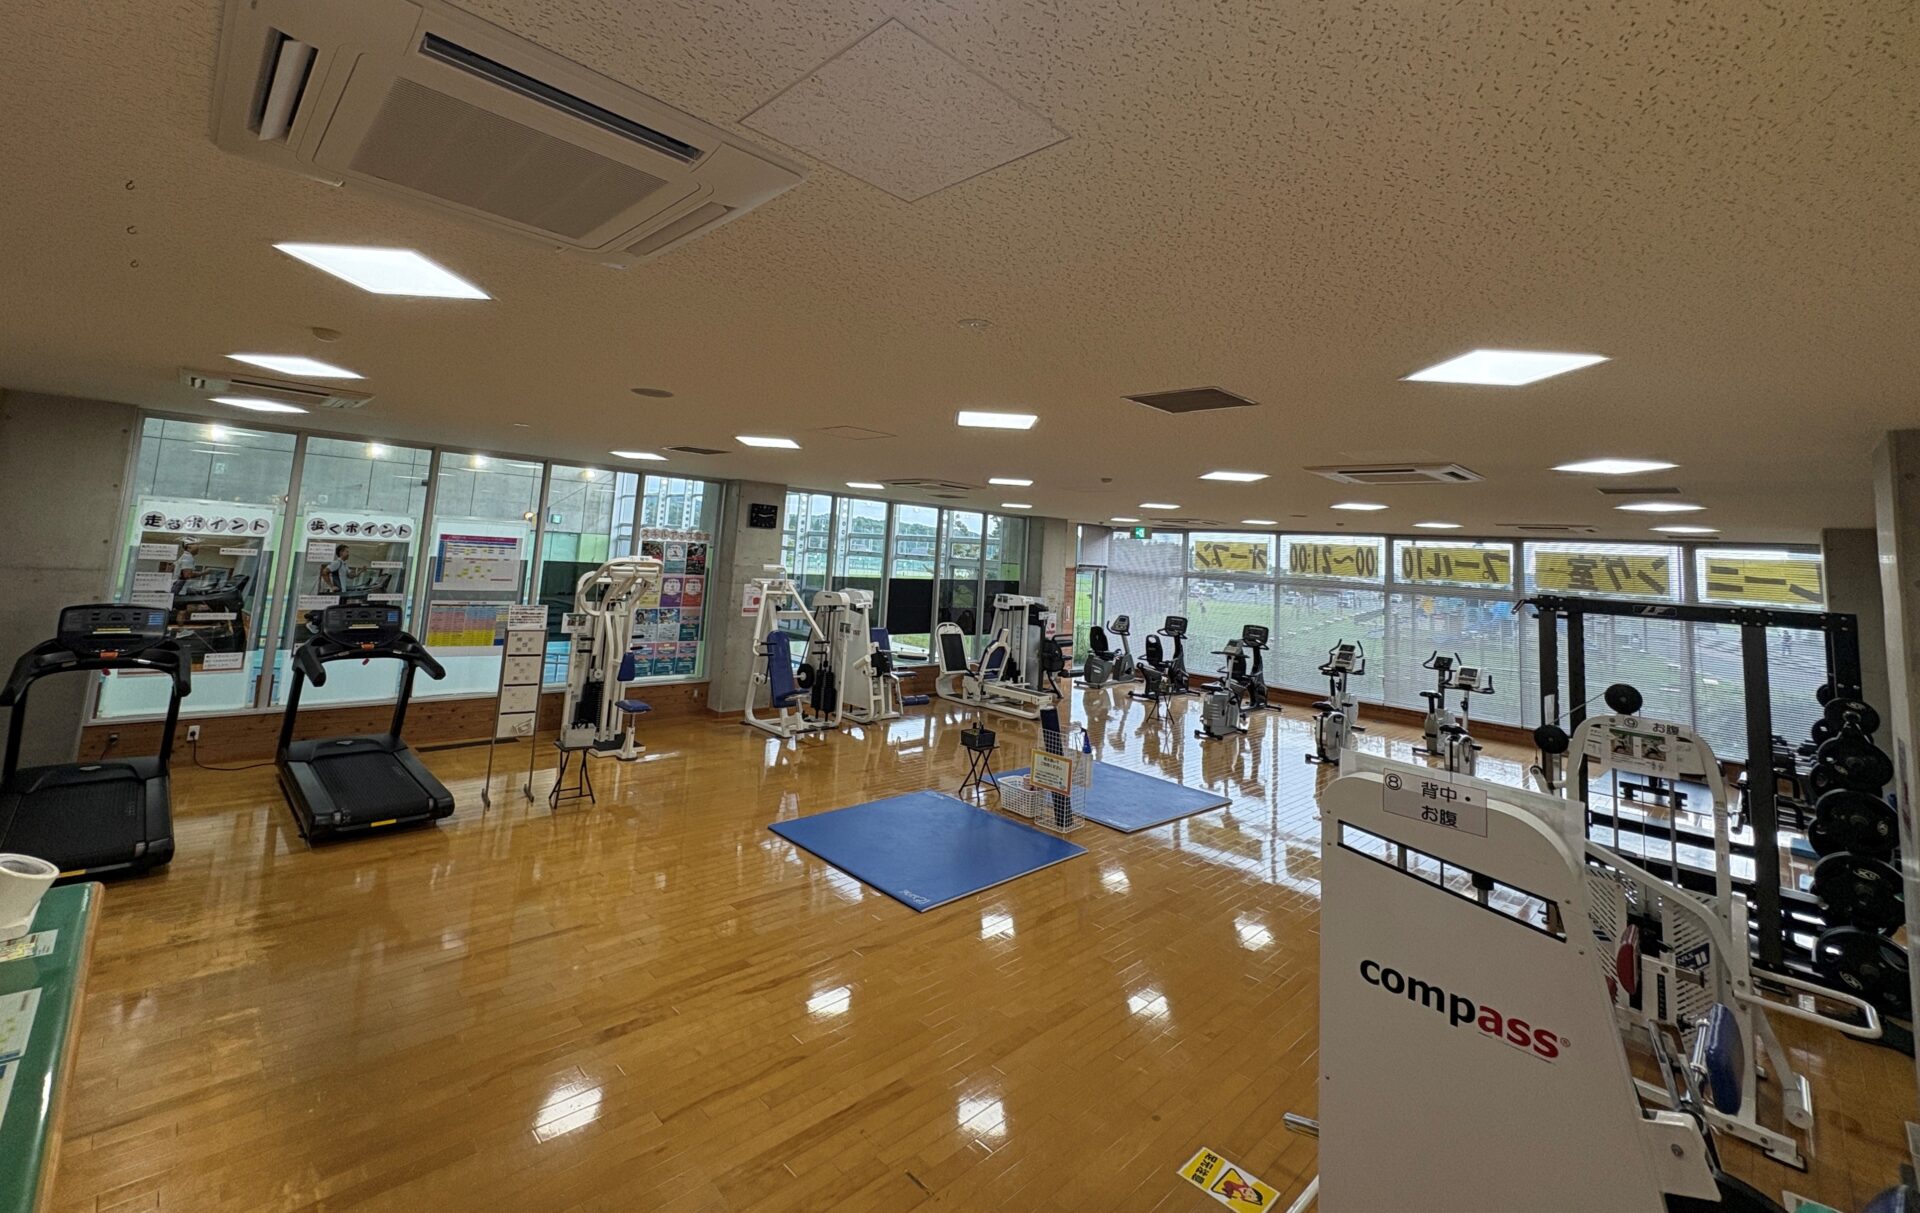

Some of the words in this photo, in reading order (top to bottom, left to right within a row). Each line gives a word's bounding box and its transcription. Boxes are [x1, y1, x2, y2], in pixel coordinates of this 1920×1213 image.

[144, 514, 265, 532] 走るポイント
[310, 520, 409, 535] 歩くポイント
[1421, 805, 1458, 829] お腹
[1360, 959, 1560, 1059] compass
